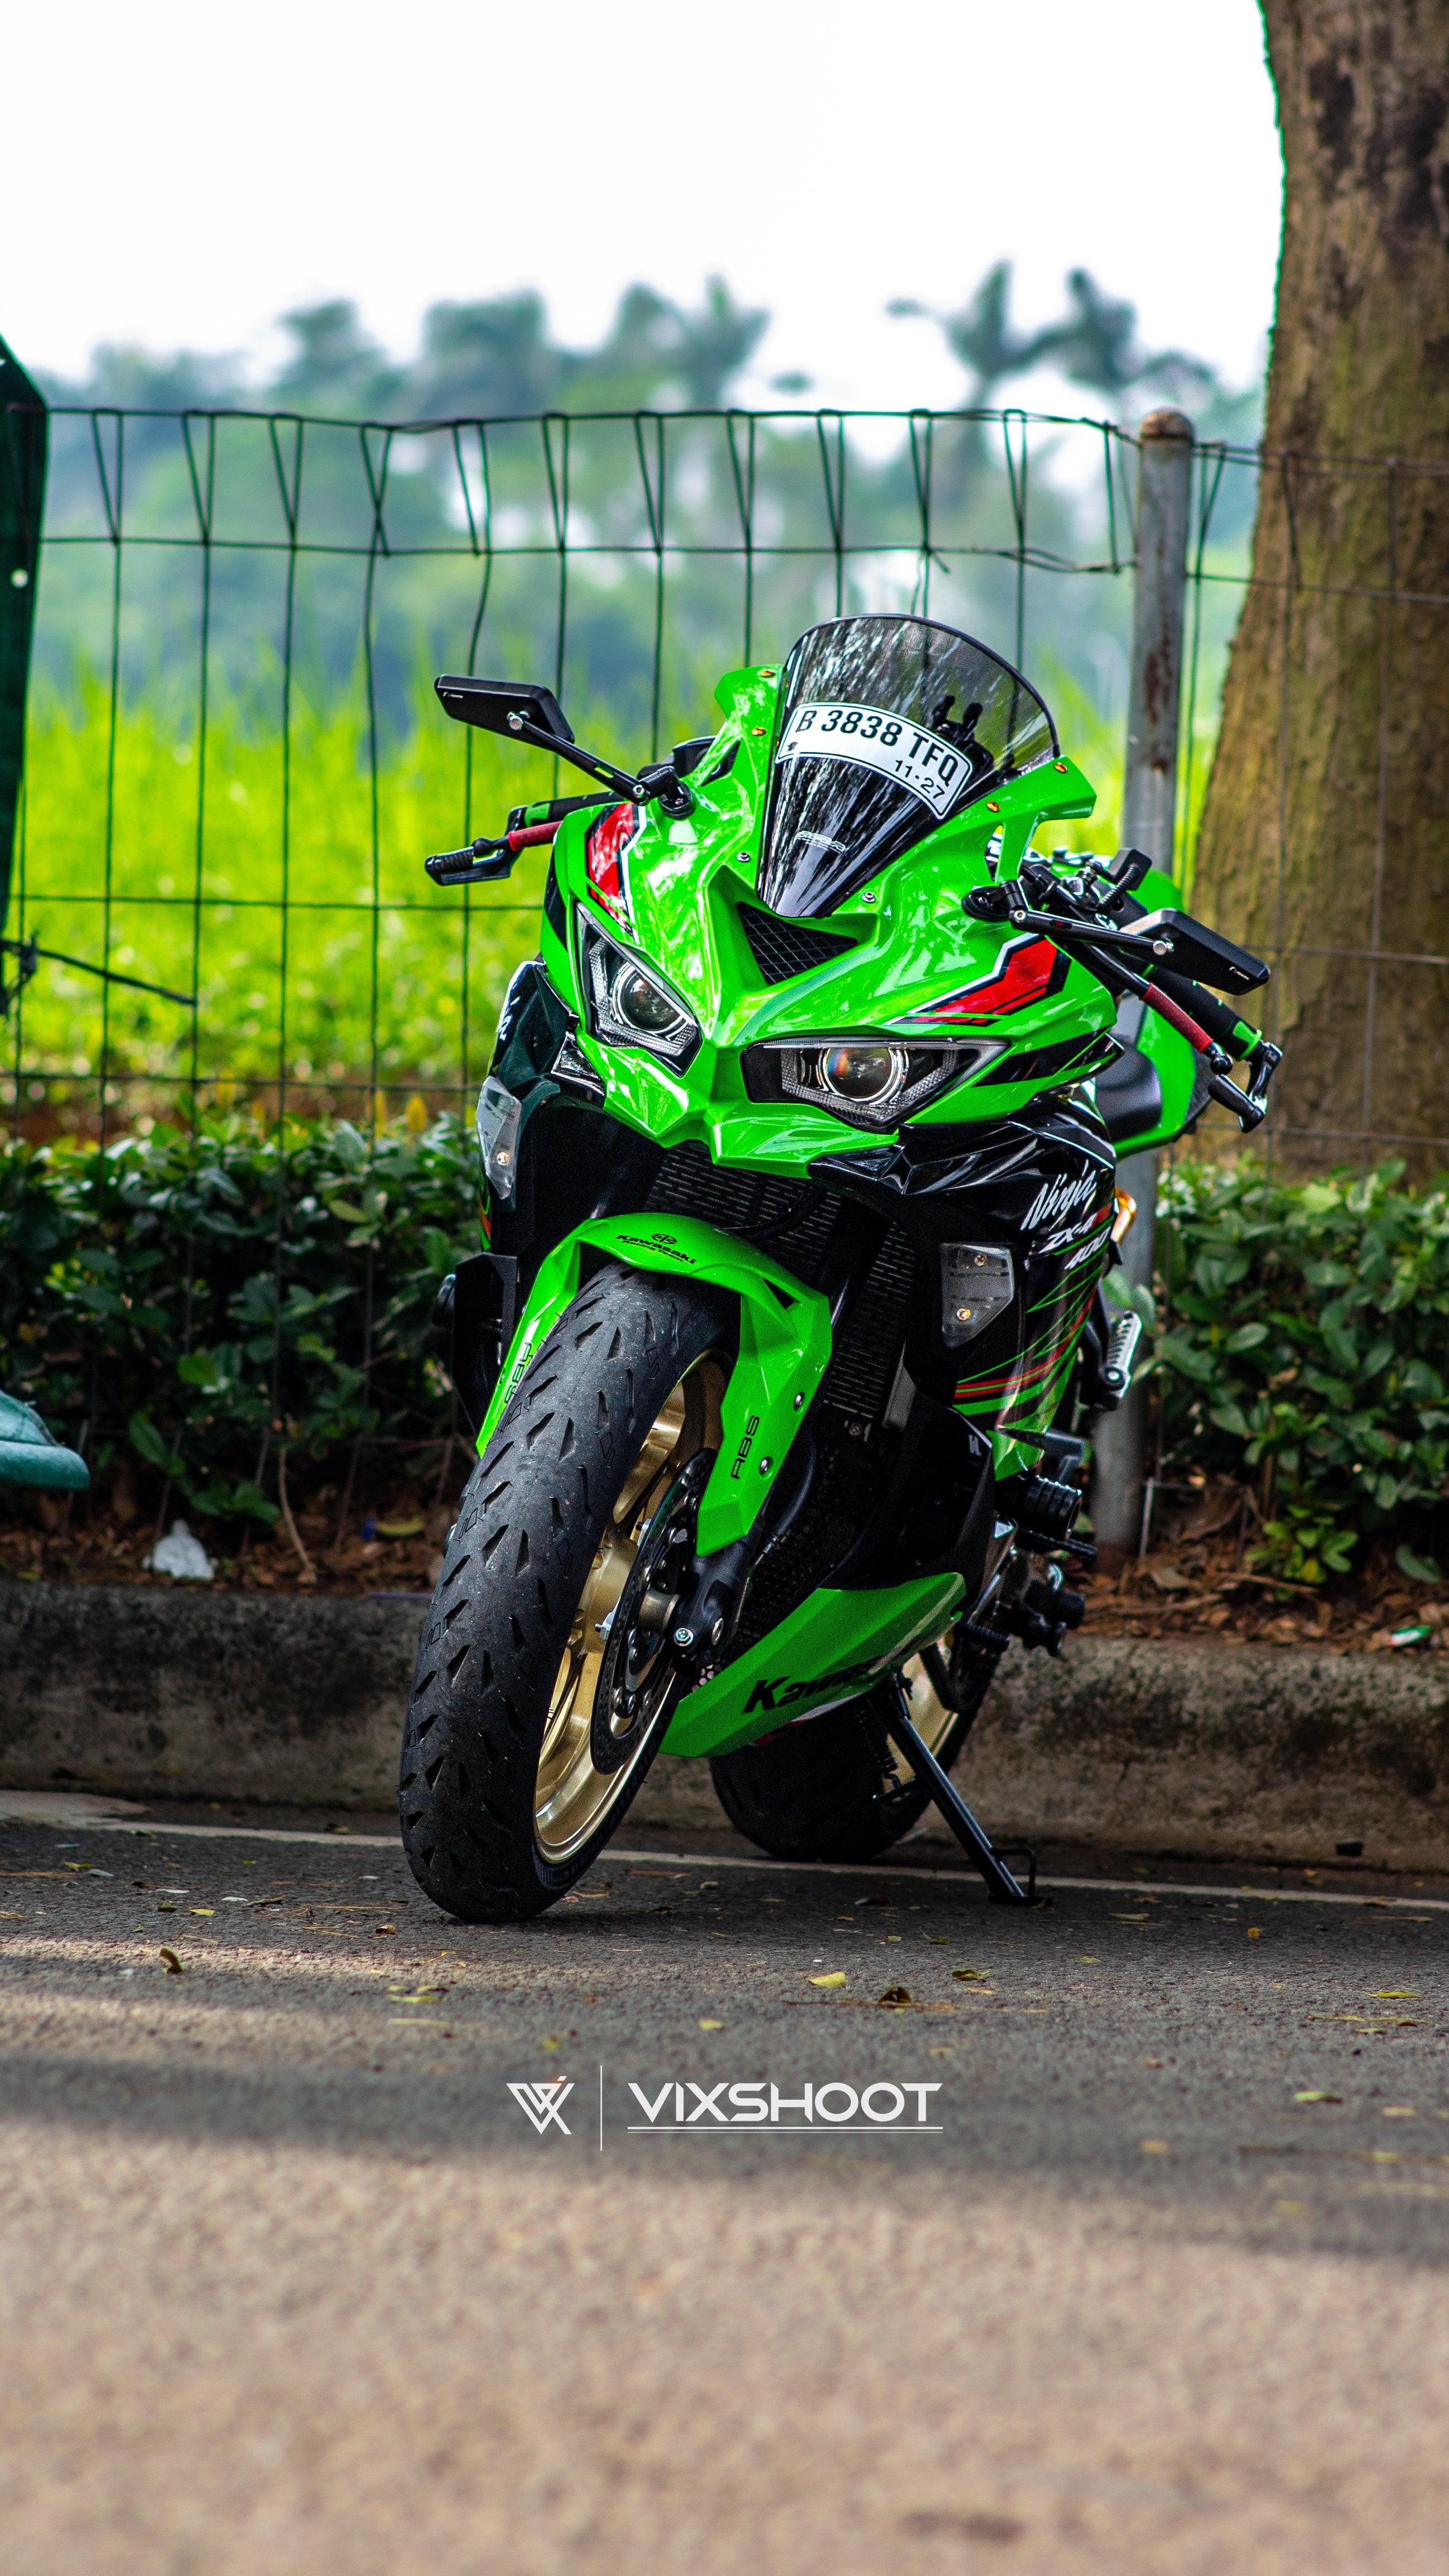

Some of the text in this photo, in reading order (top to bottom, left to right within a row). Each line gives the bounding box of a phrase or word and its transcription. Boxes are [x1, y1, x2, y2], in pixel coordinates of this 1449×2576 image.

[795, 710, 959, 788] B 3838 TFQ
[1020, 1159, 1097, 1231] Ninja
[615, 1234, 697, 1264] Kawasaki
[730, 1414, 760, 1480] ABS
